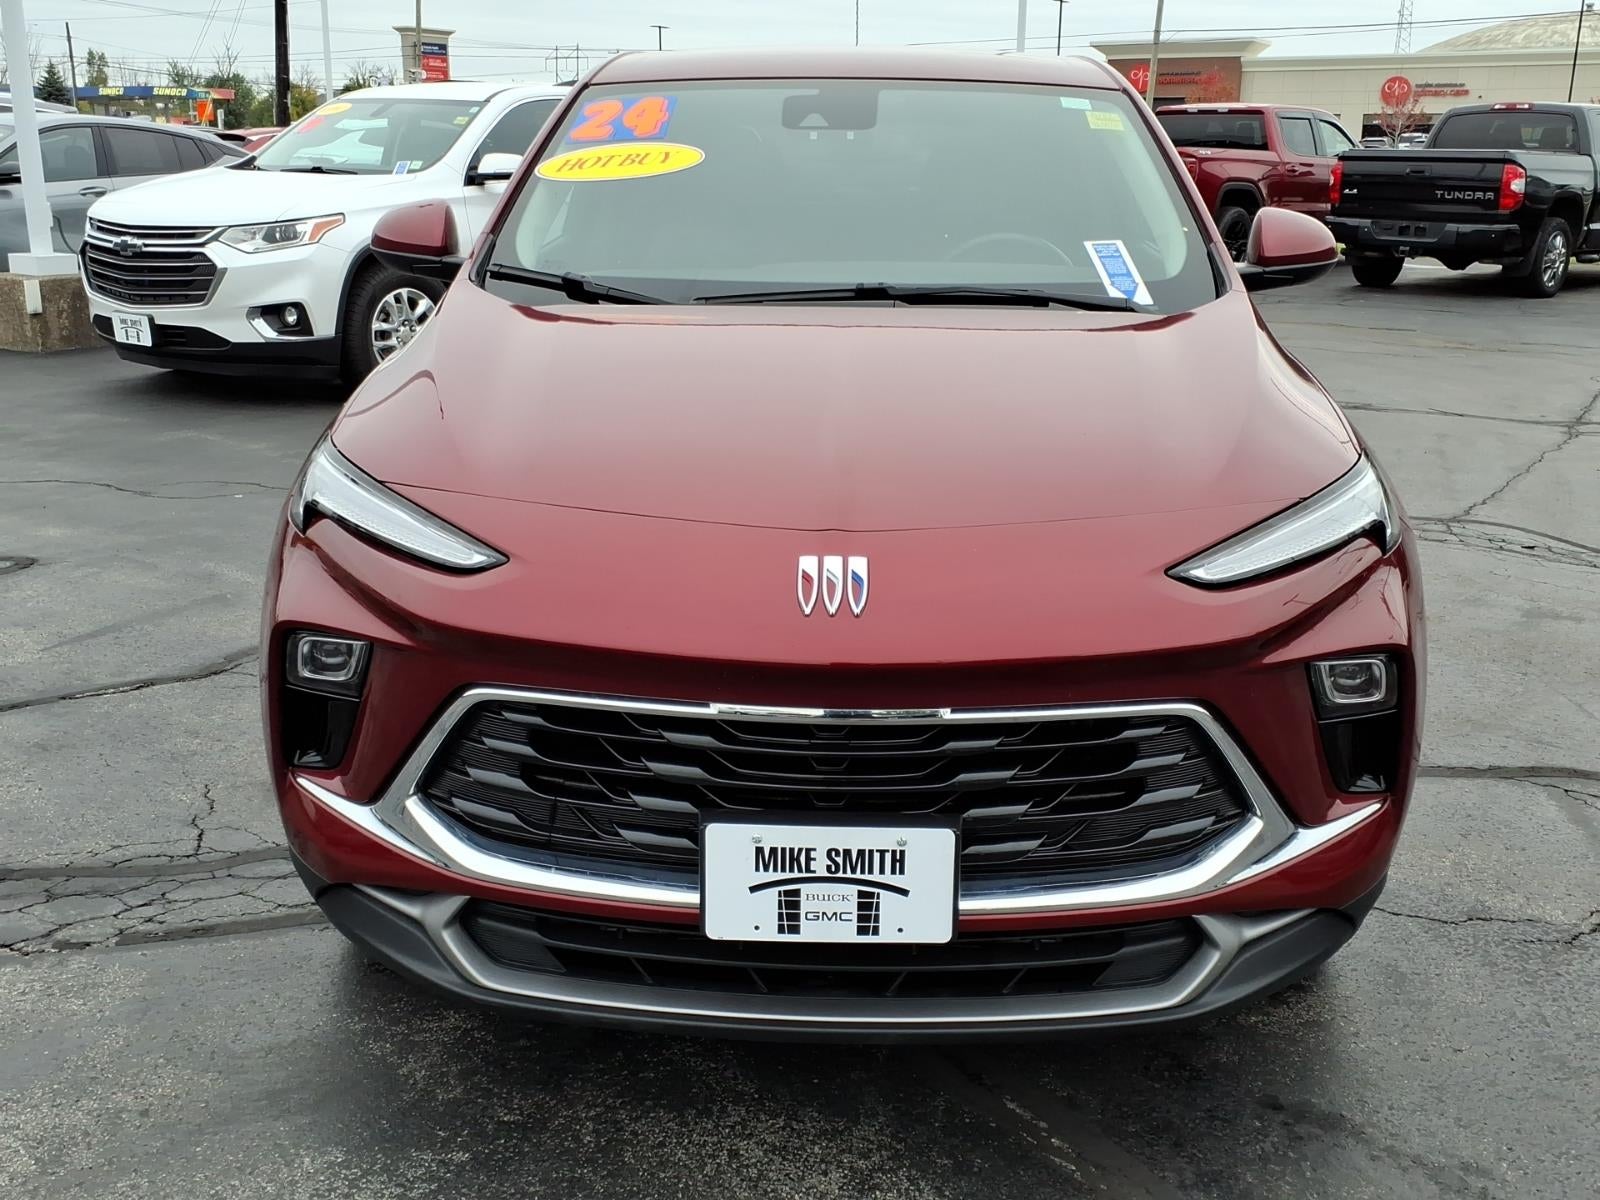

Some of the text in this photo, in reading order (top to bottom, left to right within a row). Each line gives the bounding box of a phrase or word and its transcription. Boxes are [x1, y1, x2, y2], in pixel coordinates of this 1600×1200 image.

[98, 87, 125, 96] SUNOCO
[152, 87, 188, 97] SUNOCO
[569, 96, 669, 141] 24
[555, 151, 680, 173] HOT BUY
[1435, 190, 1495, 200] TUNDRA
[754, 846, 906, 876] MIKE SMITH
[805, 893, 851, 902] BUICK
[805, 911, 853, 922] GMC
